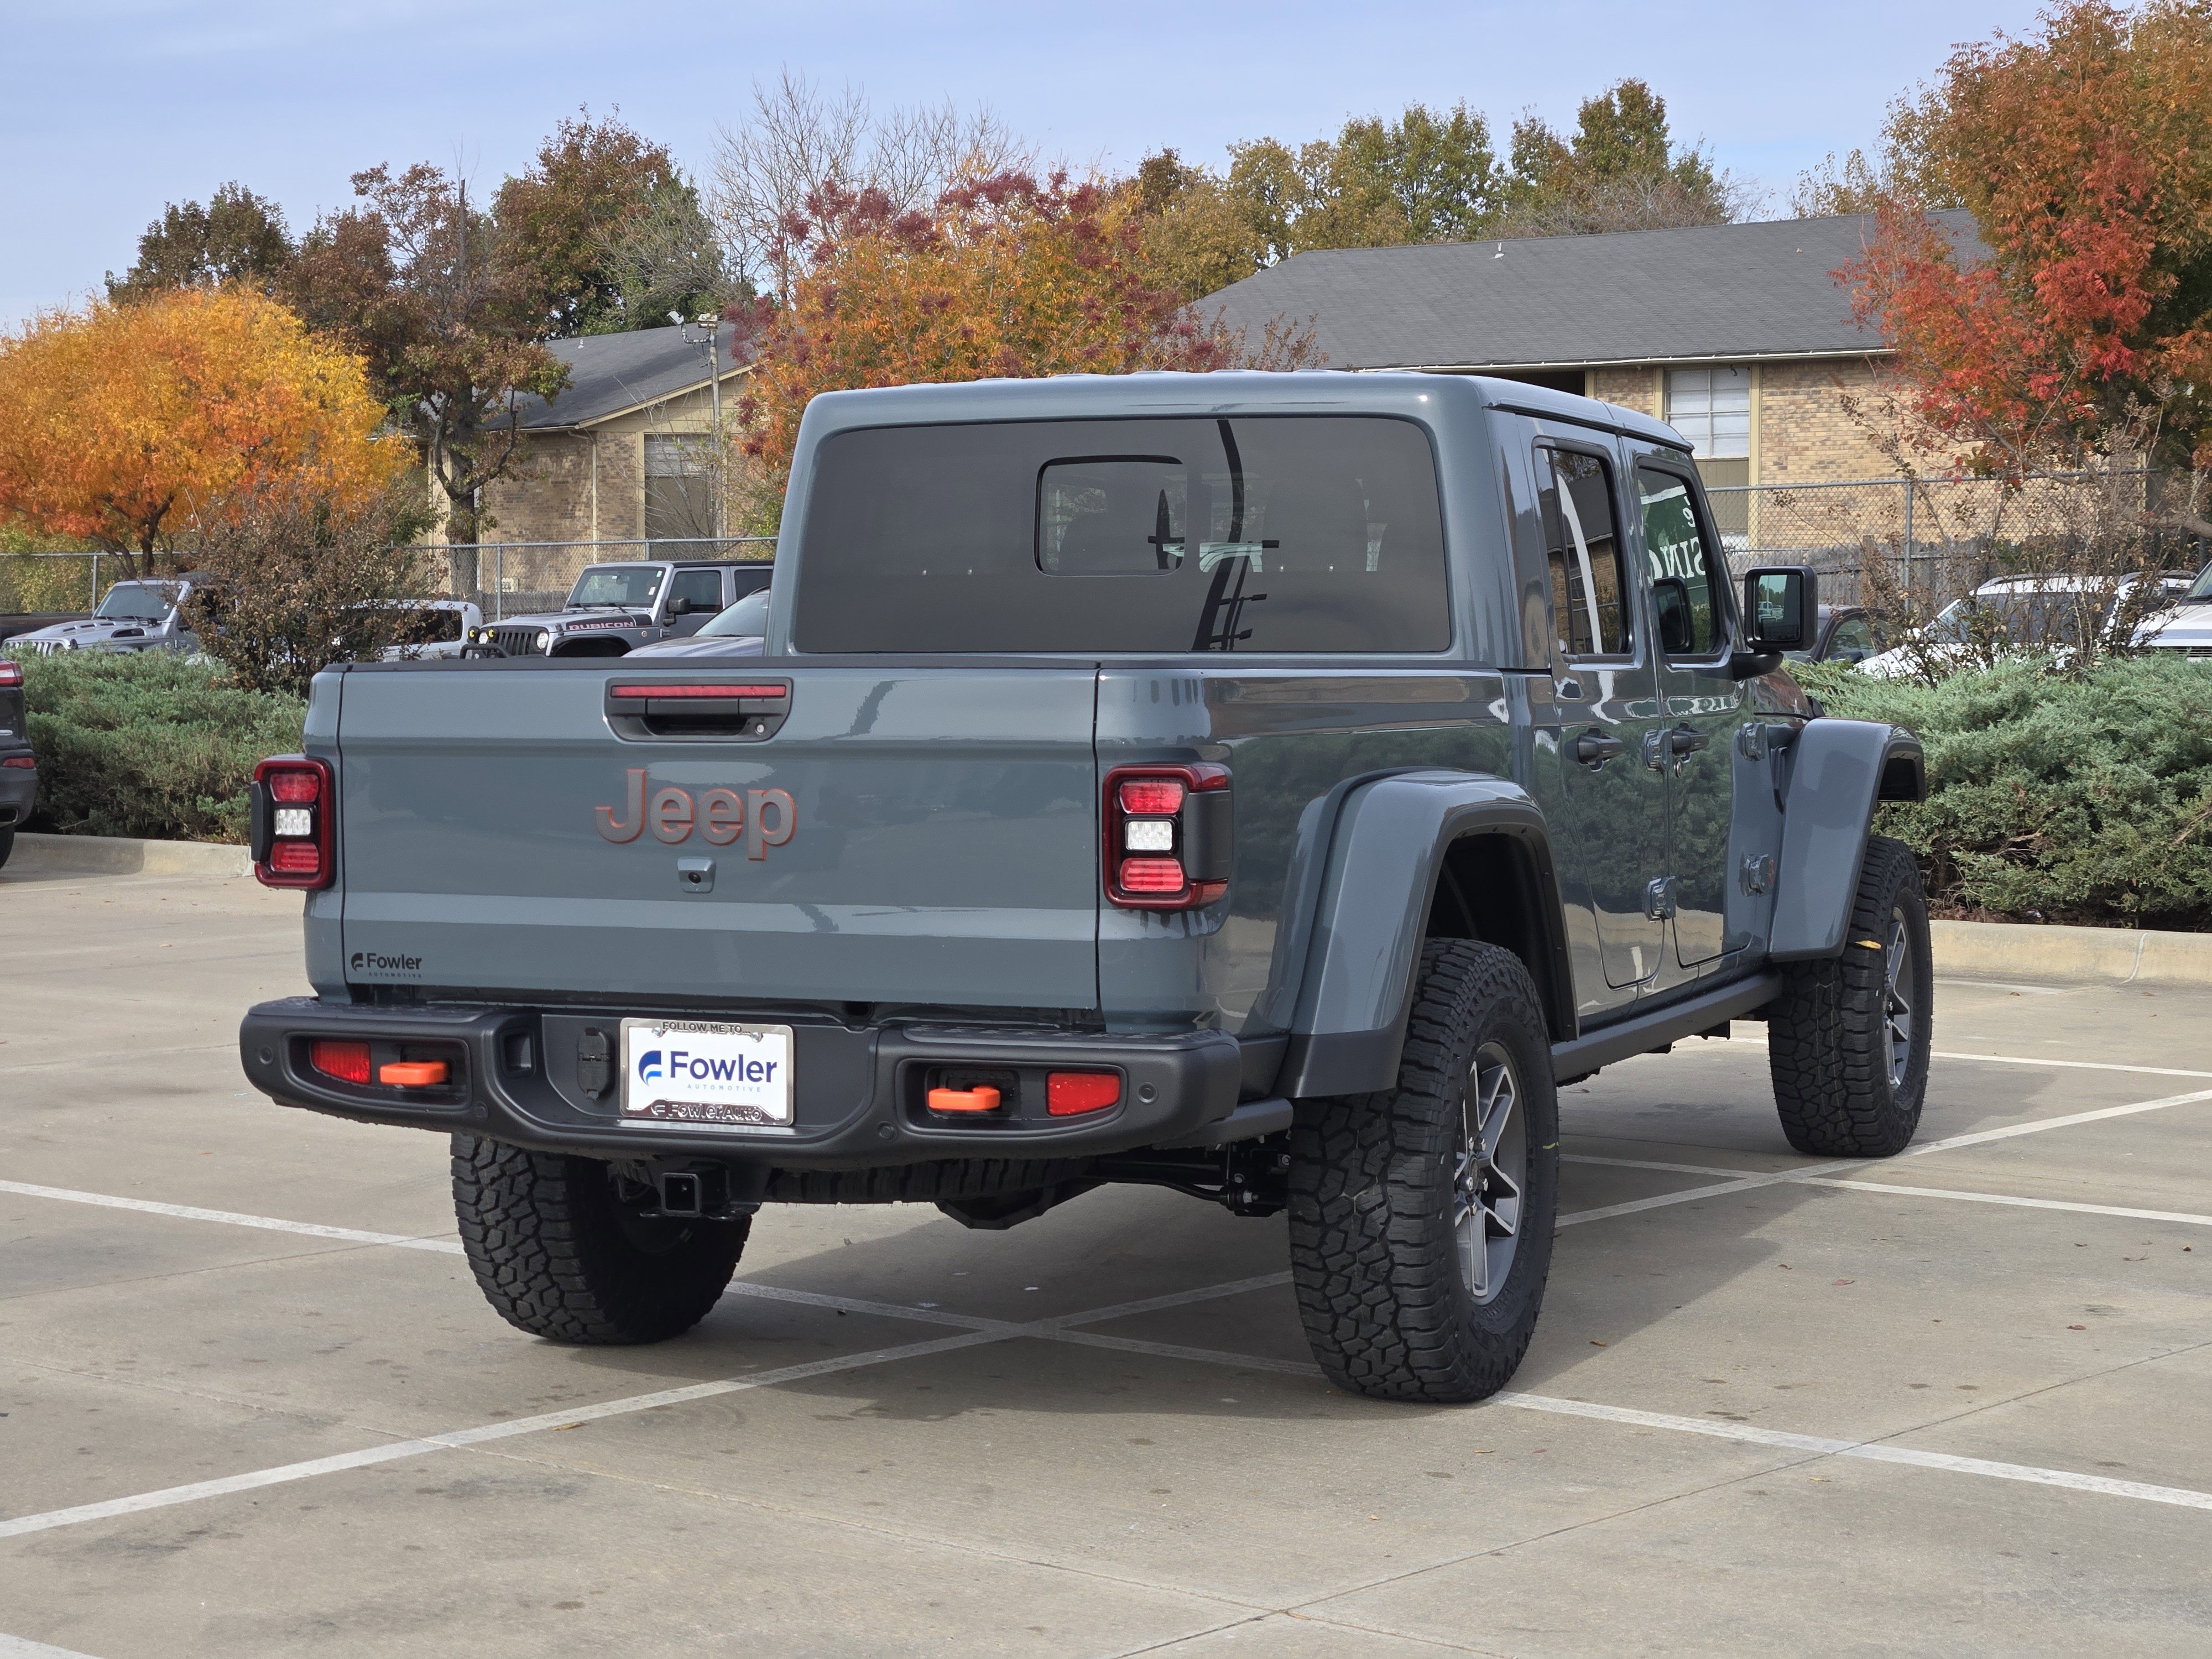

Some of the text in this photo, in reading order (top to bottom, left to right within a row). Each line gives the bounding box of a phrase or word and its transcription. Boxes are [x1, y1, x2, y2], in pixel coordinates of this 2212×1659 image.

[568, 622, 634, 630] RUBICON
[594, 768, 797, 862] Jeep
[367, 952, 422, 970] Fowler
[662, 1021, 709, 1033] FOLLOW
[712, 1024, 726, 1034] ME
[670, 1051, 778, 1083] Fowler
[687, 1084, 761, 1092] AUTOMOTIVE
